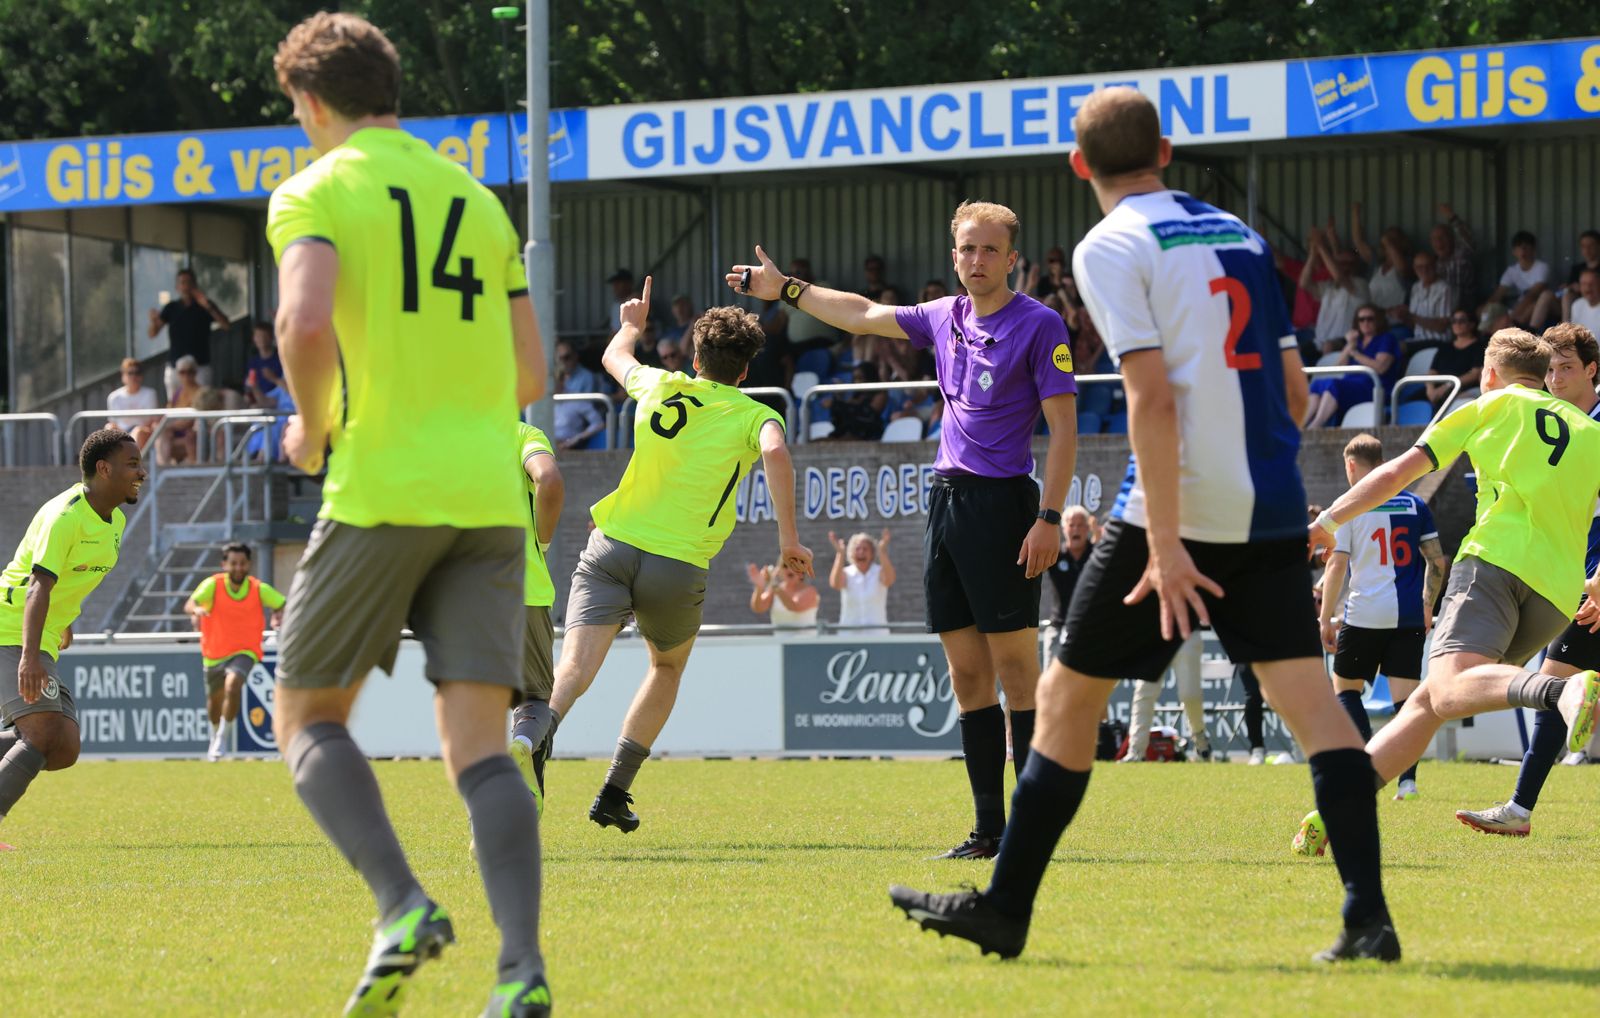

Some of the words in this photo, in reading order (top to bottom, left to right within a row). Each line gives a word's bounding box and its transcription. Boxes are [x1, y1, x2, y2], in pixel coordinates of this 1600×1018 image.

[1406, 52, 1548, 123] Gijs
[622, 74, 1250, 168] GIJSVANCLEENL
[46, 143, 154, 202] Gijs
[173, 137, 215, 196] &
[387, 186, 484, 322] 14
[1208, 276, 1263, 371] 2
[650, 391, 705, 440] 5
[1535, 408, 1570, 467] 9
[804, 466, 870, 520] DER
[876, 463, 936, 518] GEE
[1370, 526, 1412, 567] 16
[74, 665, 156, 699] PARKET
[162, 671, 189, 699] en
[76, 708, 126, 743] UTEN
[131, 708, 210, 742] VLOERE
